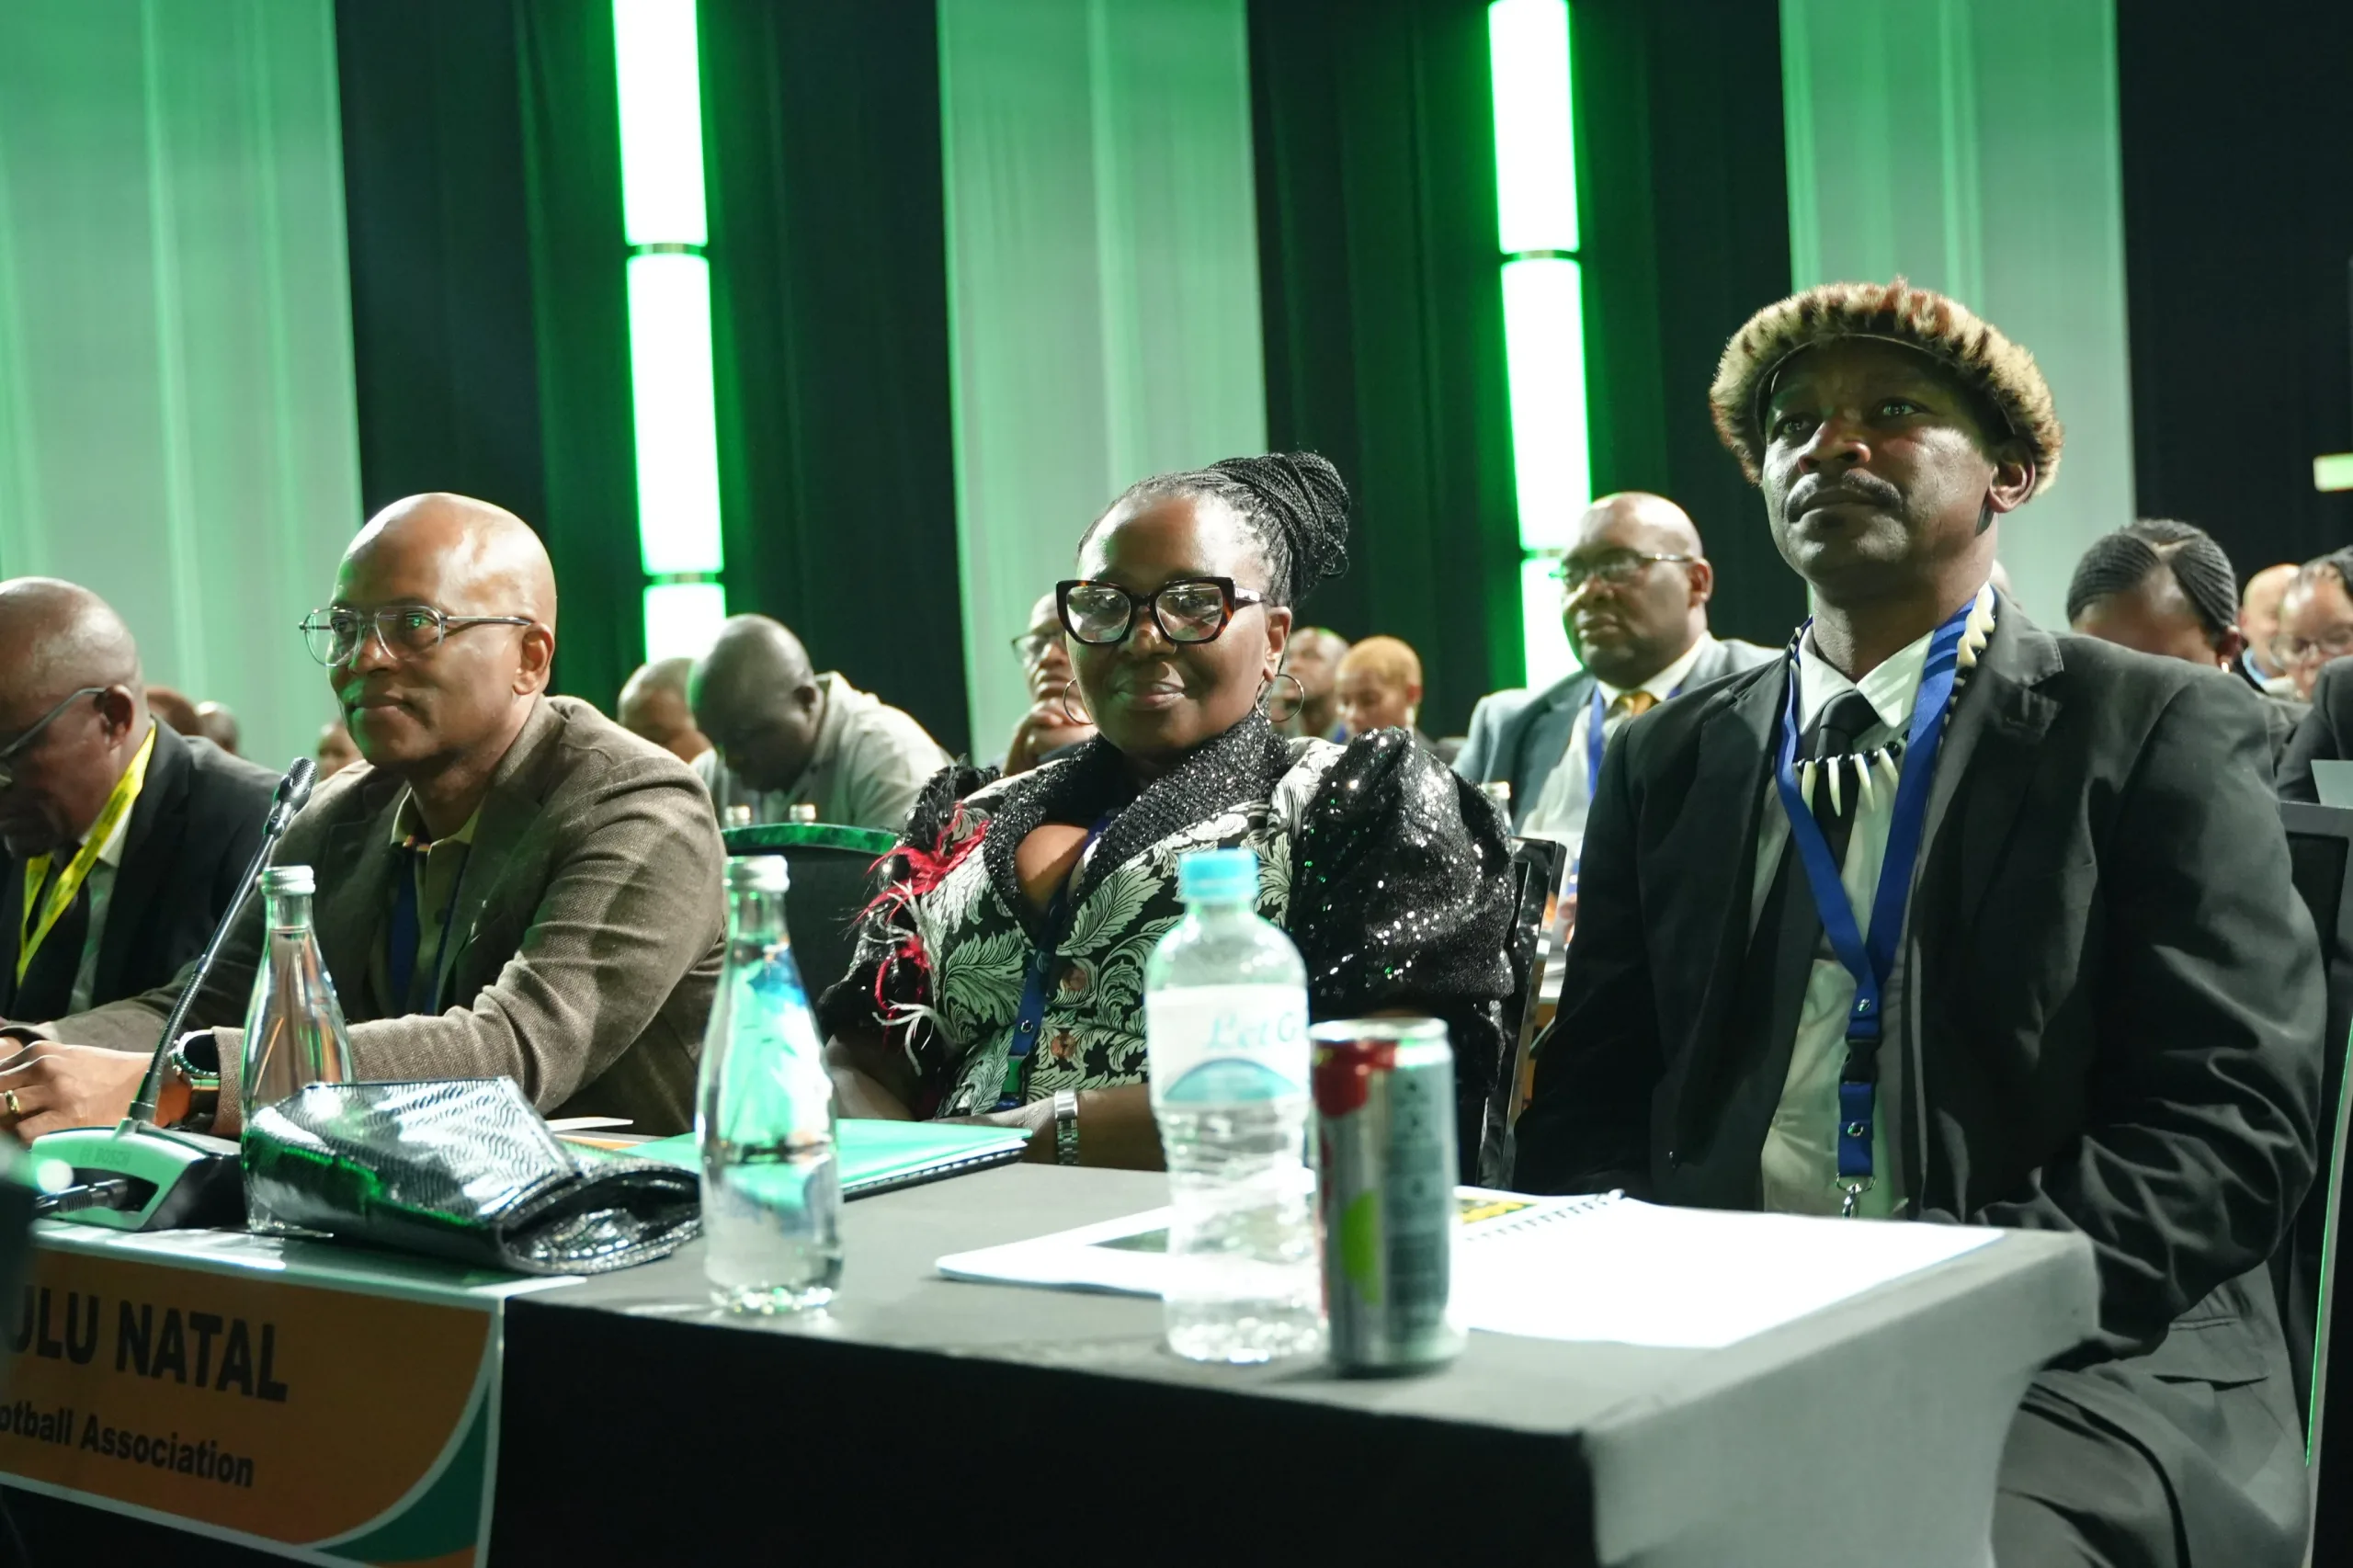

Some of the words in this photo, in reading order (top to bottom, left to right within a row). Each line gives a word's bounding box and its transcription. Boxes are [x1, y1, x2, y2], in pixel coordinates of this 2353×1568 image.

[94, 1146, 131, 1167] BOSCH
[115, 1300, 289, 1403] NATAL
[80, 1413, 255, 1488] Association
